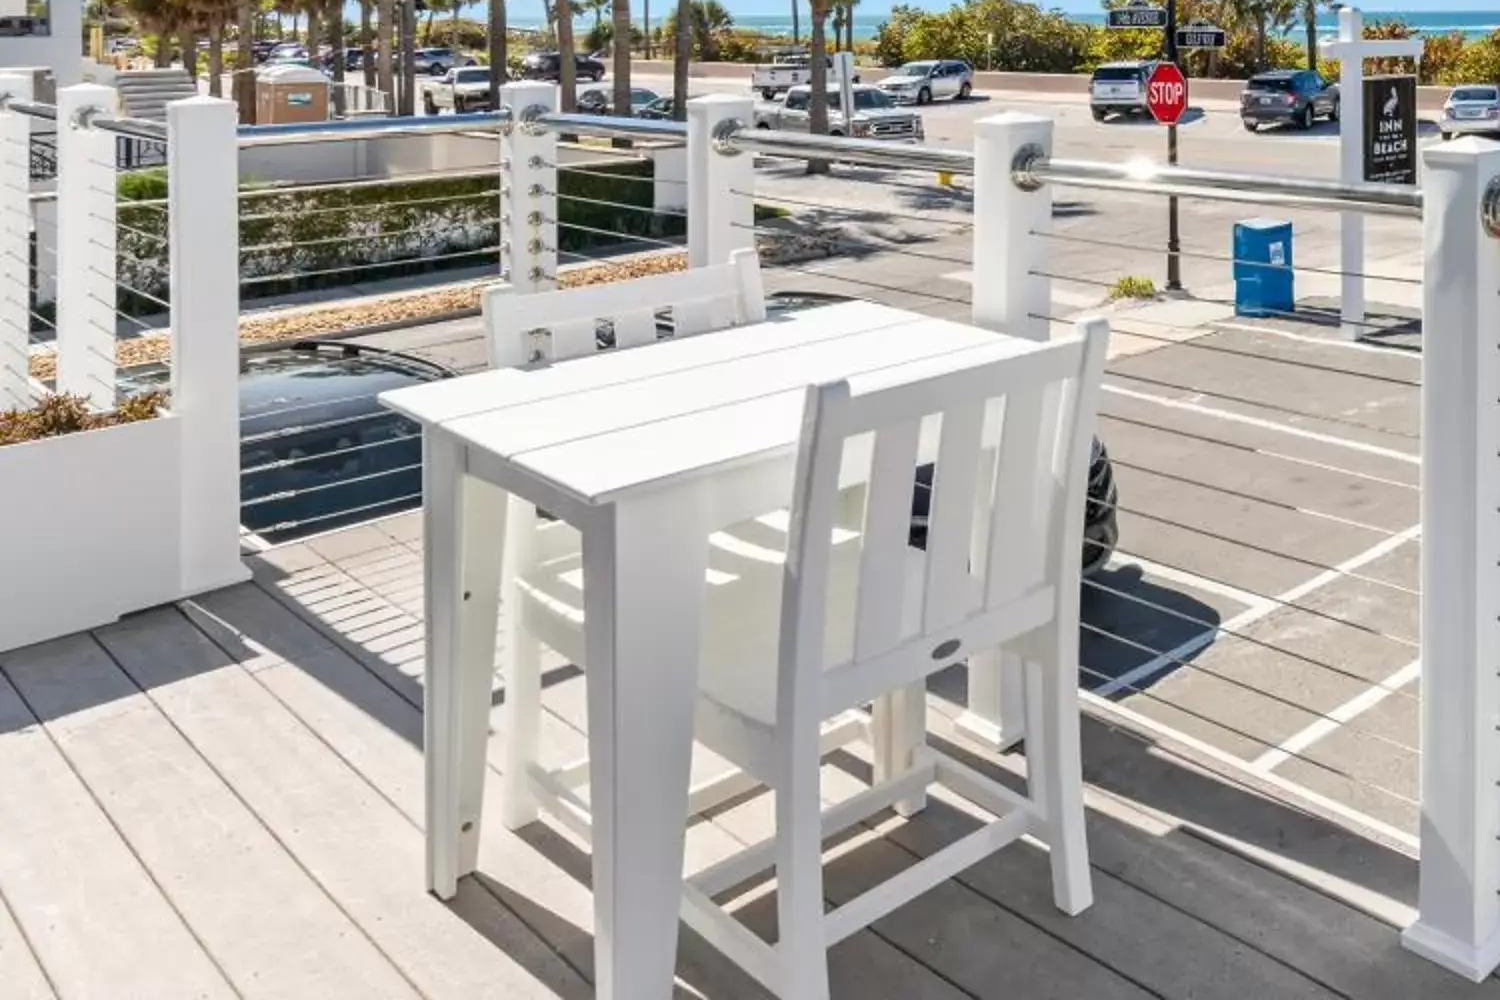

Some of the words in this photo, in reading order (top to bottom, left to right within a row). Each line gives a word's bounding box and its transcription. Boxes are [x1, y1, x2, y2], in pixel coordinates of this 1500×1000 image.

[1149, 81, 1183, 105] STOP
[1379, 119, 1403, 133] INN
[1373, 139, 1408, 155] BEACH
